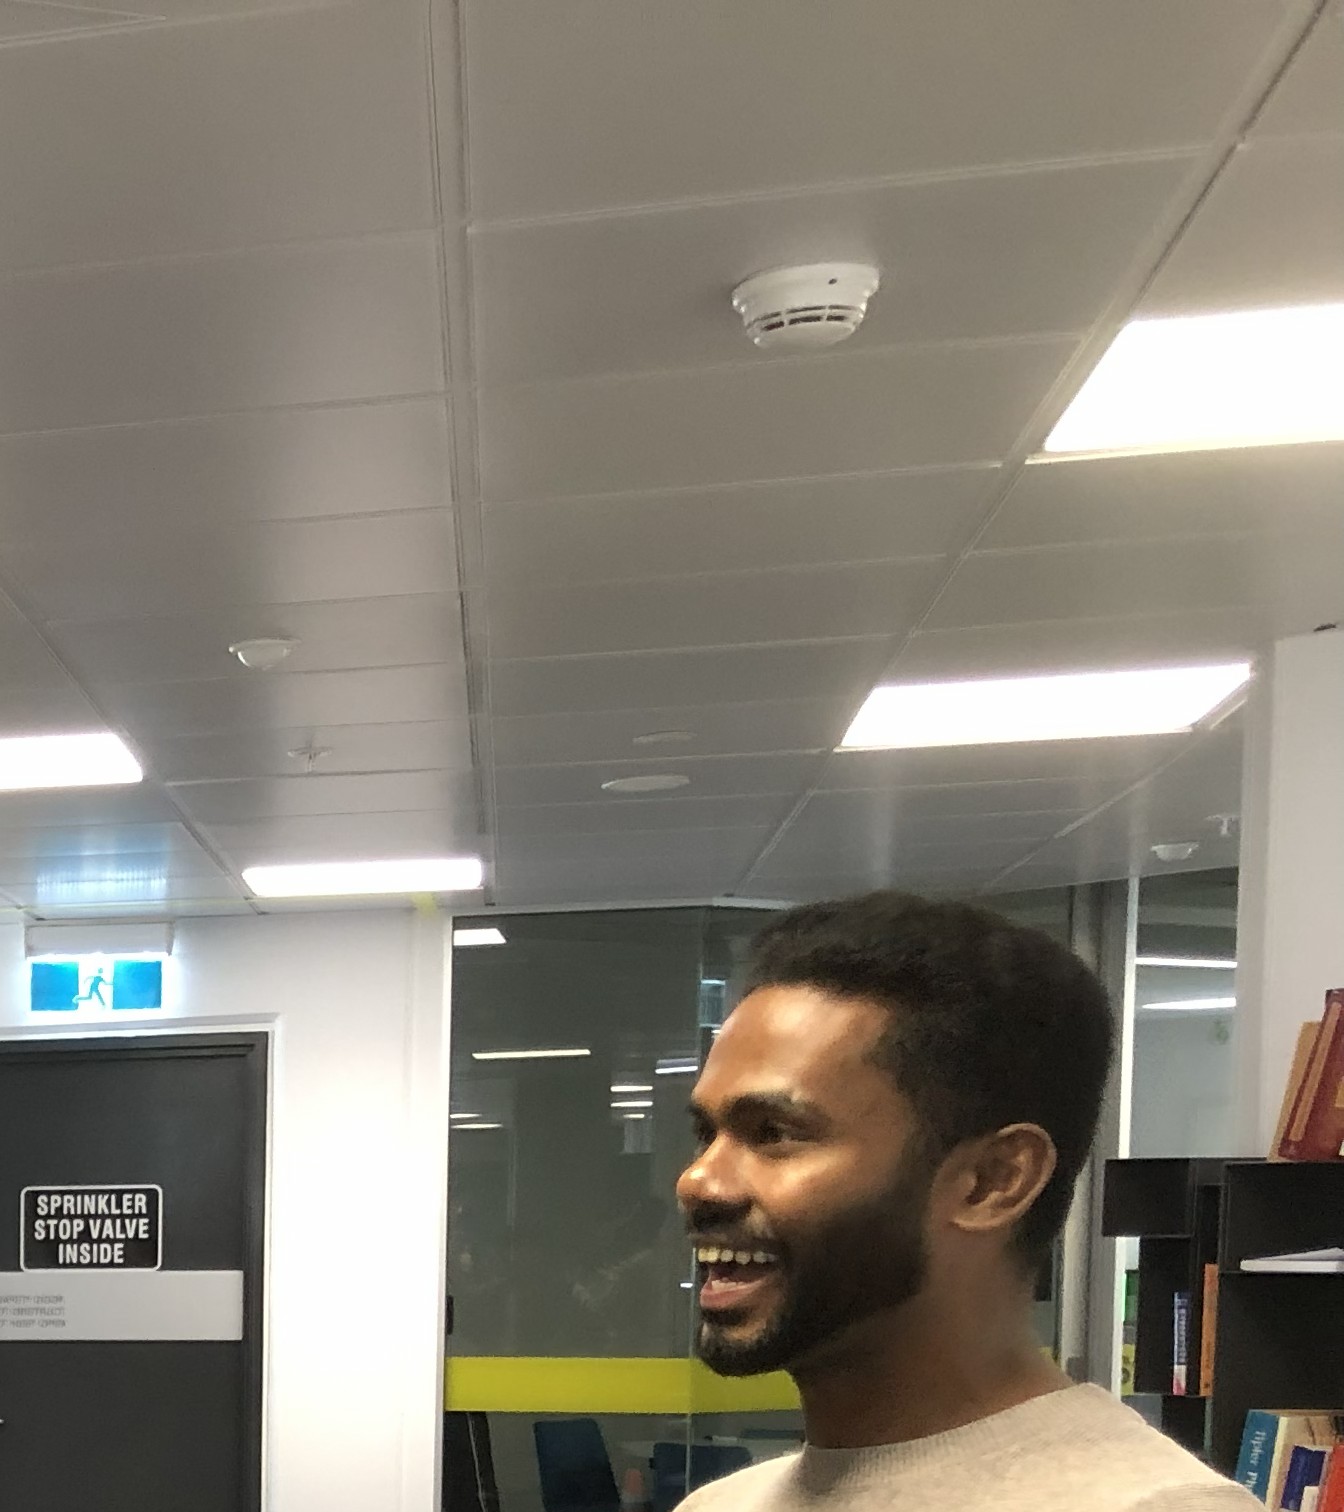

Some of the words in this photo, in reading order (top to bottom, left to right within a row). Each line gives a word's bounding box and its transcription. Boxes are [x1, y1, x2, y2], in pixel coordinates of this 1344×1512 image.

[36, 1193, 147, 1216] SPRINKLER
[34, 1218, 85, 1240] STOP
[88, 1217, 150, 1240] VALVE
[58, 1242, 125, 1265] INSIDE
